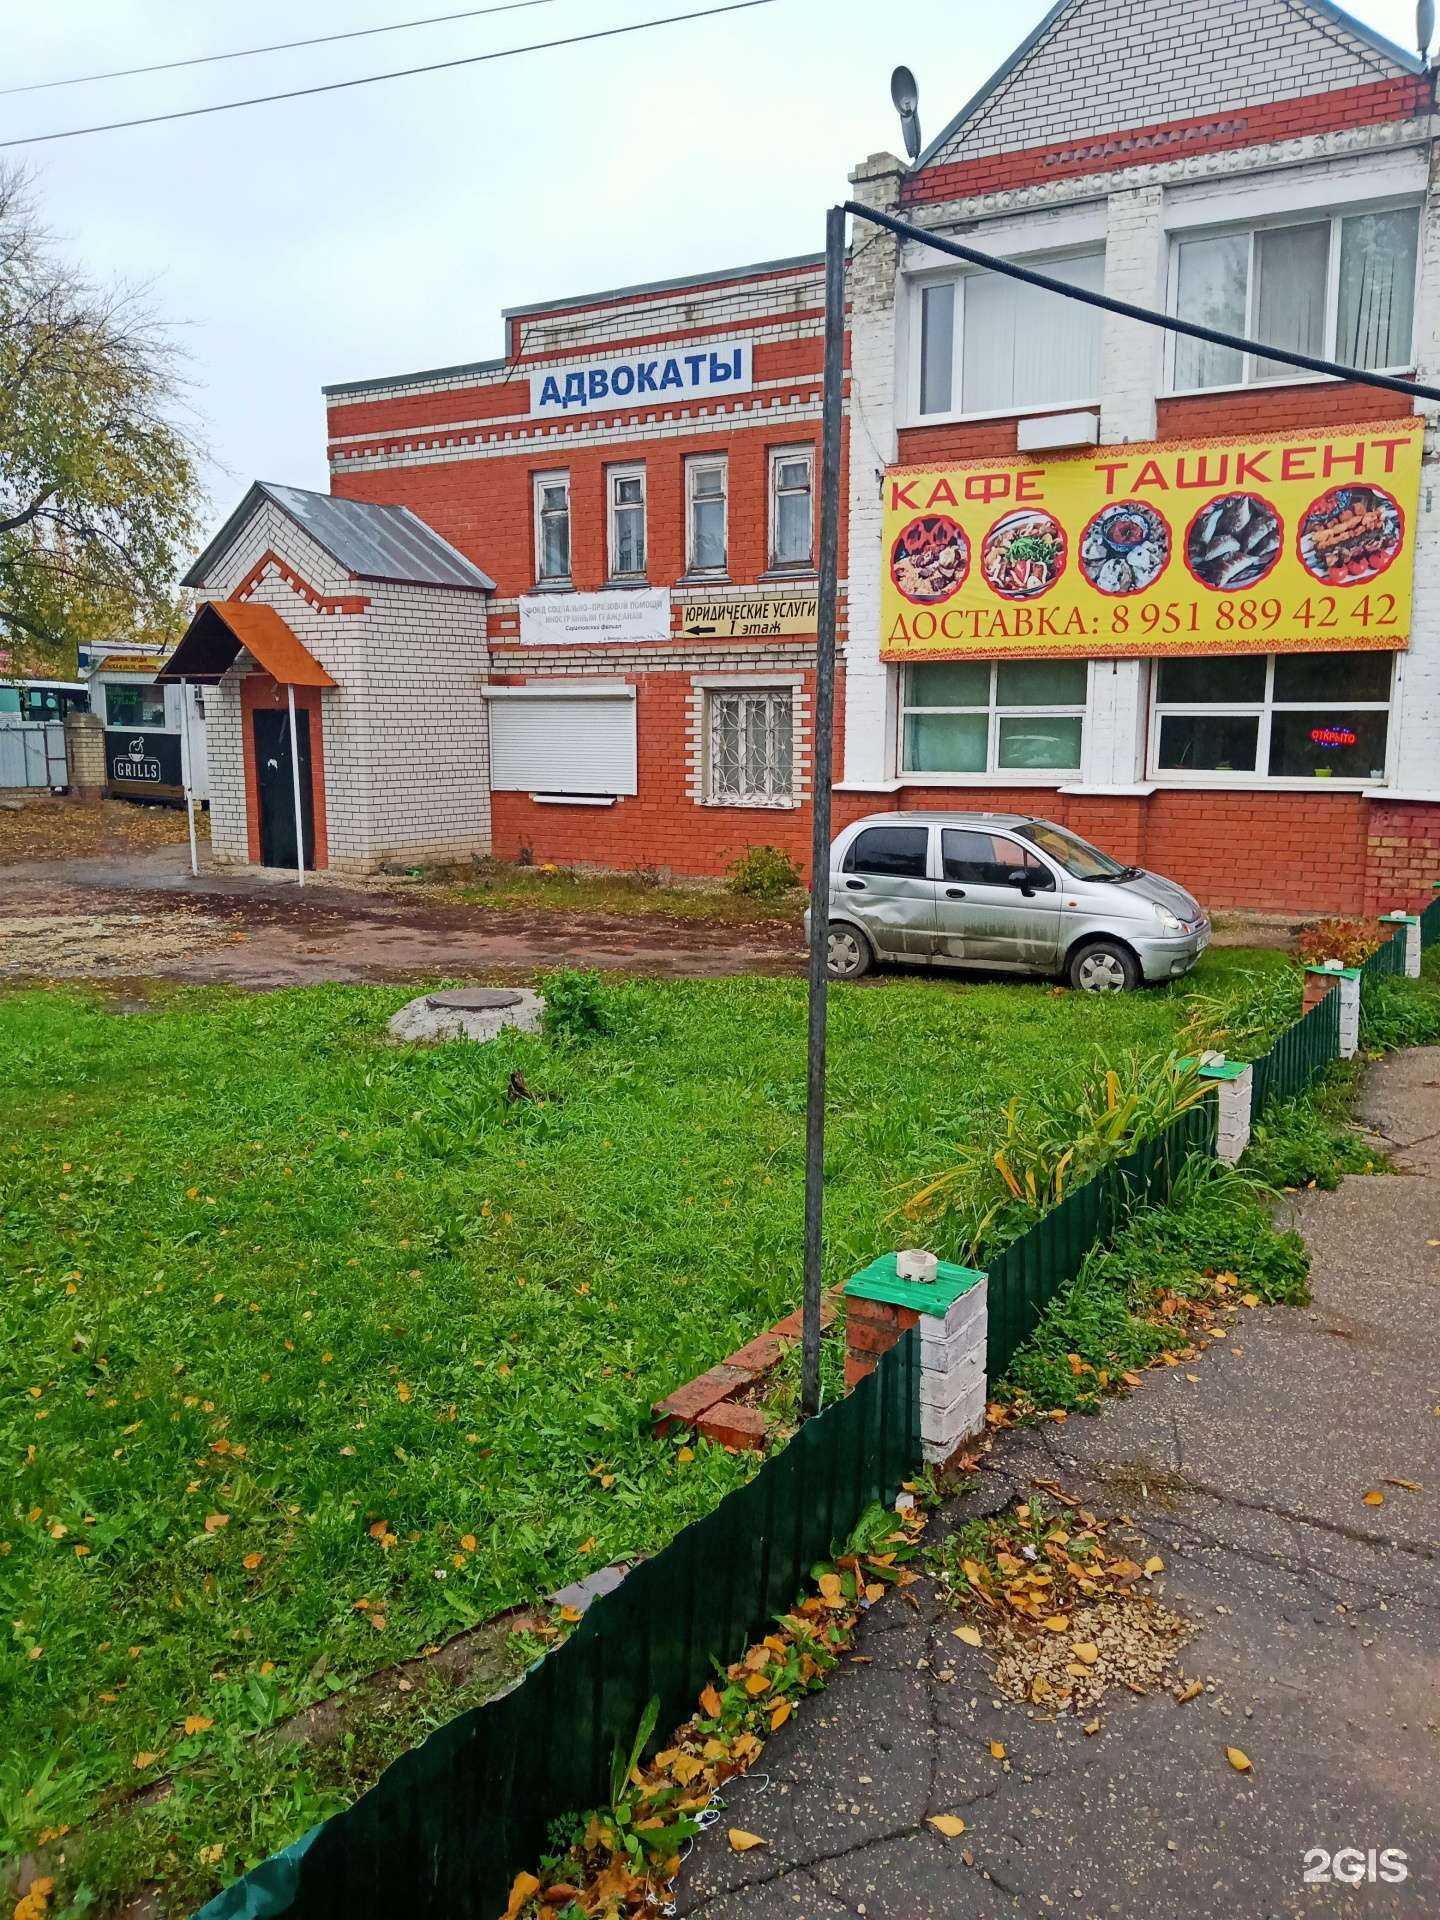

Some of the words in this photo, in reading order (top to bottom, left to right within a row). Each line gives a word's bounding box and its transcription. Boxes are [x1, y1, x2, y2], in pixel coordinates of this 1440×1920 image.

[540, 348, 742, 409] АДВОКАТЫ
[891, 470, 1046, 511] КАФЕ
[1094, 438, 1412, 495] ТАШКЕНТ
[685, 602, 769, 622] ЮРИДИЧЕСКИЕ
[772, 600, 817, 618] УСЛУГИ
[888, 606, 1099, 647] ДОСТАВКА:
[1111, 604, 1129, 634] 8
[1141, 601, 1201, 635] 951
[1216, 598, 1283, 632] 889
[1292, 596, 1338, 629] 42
[1351, 593, 1399, 626] 42
[741, 621, 781, 635] этаж
[1311, 729, 1355, 744] ОТКРЫТО
[117, 762, 157, 778] GRILLS
